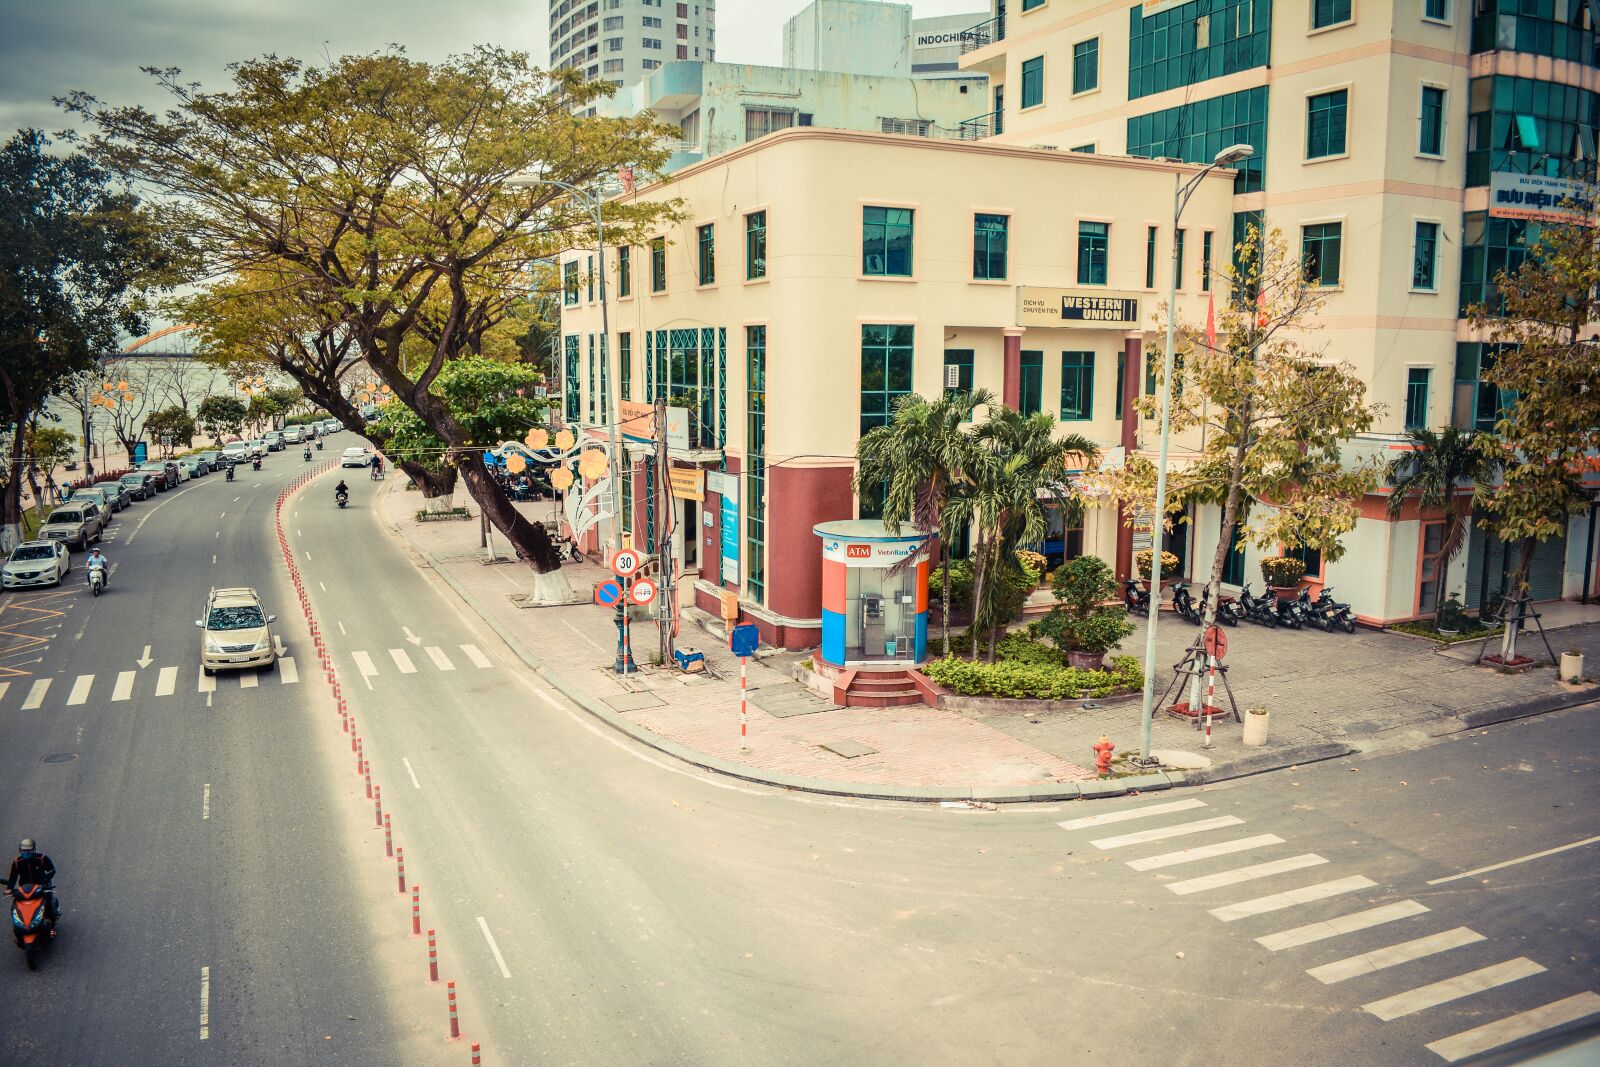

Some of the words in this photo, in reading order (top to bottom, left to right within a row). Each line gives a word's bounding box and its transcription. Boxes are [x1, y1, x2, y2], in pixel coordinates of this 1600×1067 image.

[918, 32, 974, 45] INDOCHINA
[1063, 297, 1122, 310] WESTERN
[1083, 309, 1122, 321] UNION
[848, 547, 870, 556] ATM
[877, 548, 909, 556] VietinBank
[620, 556, 632, 569] 30
